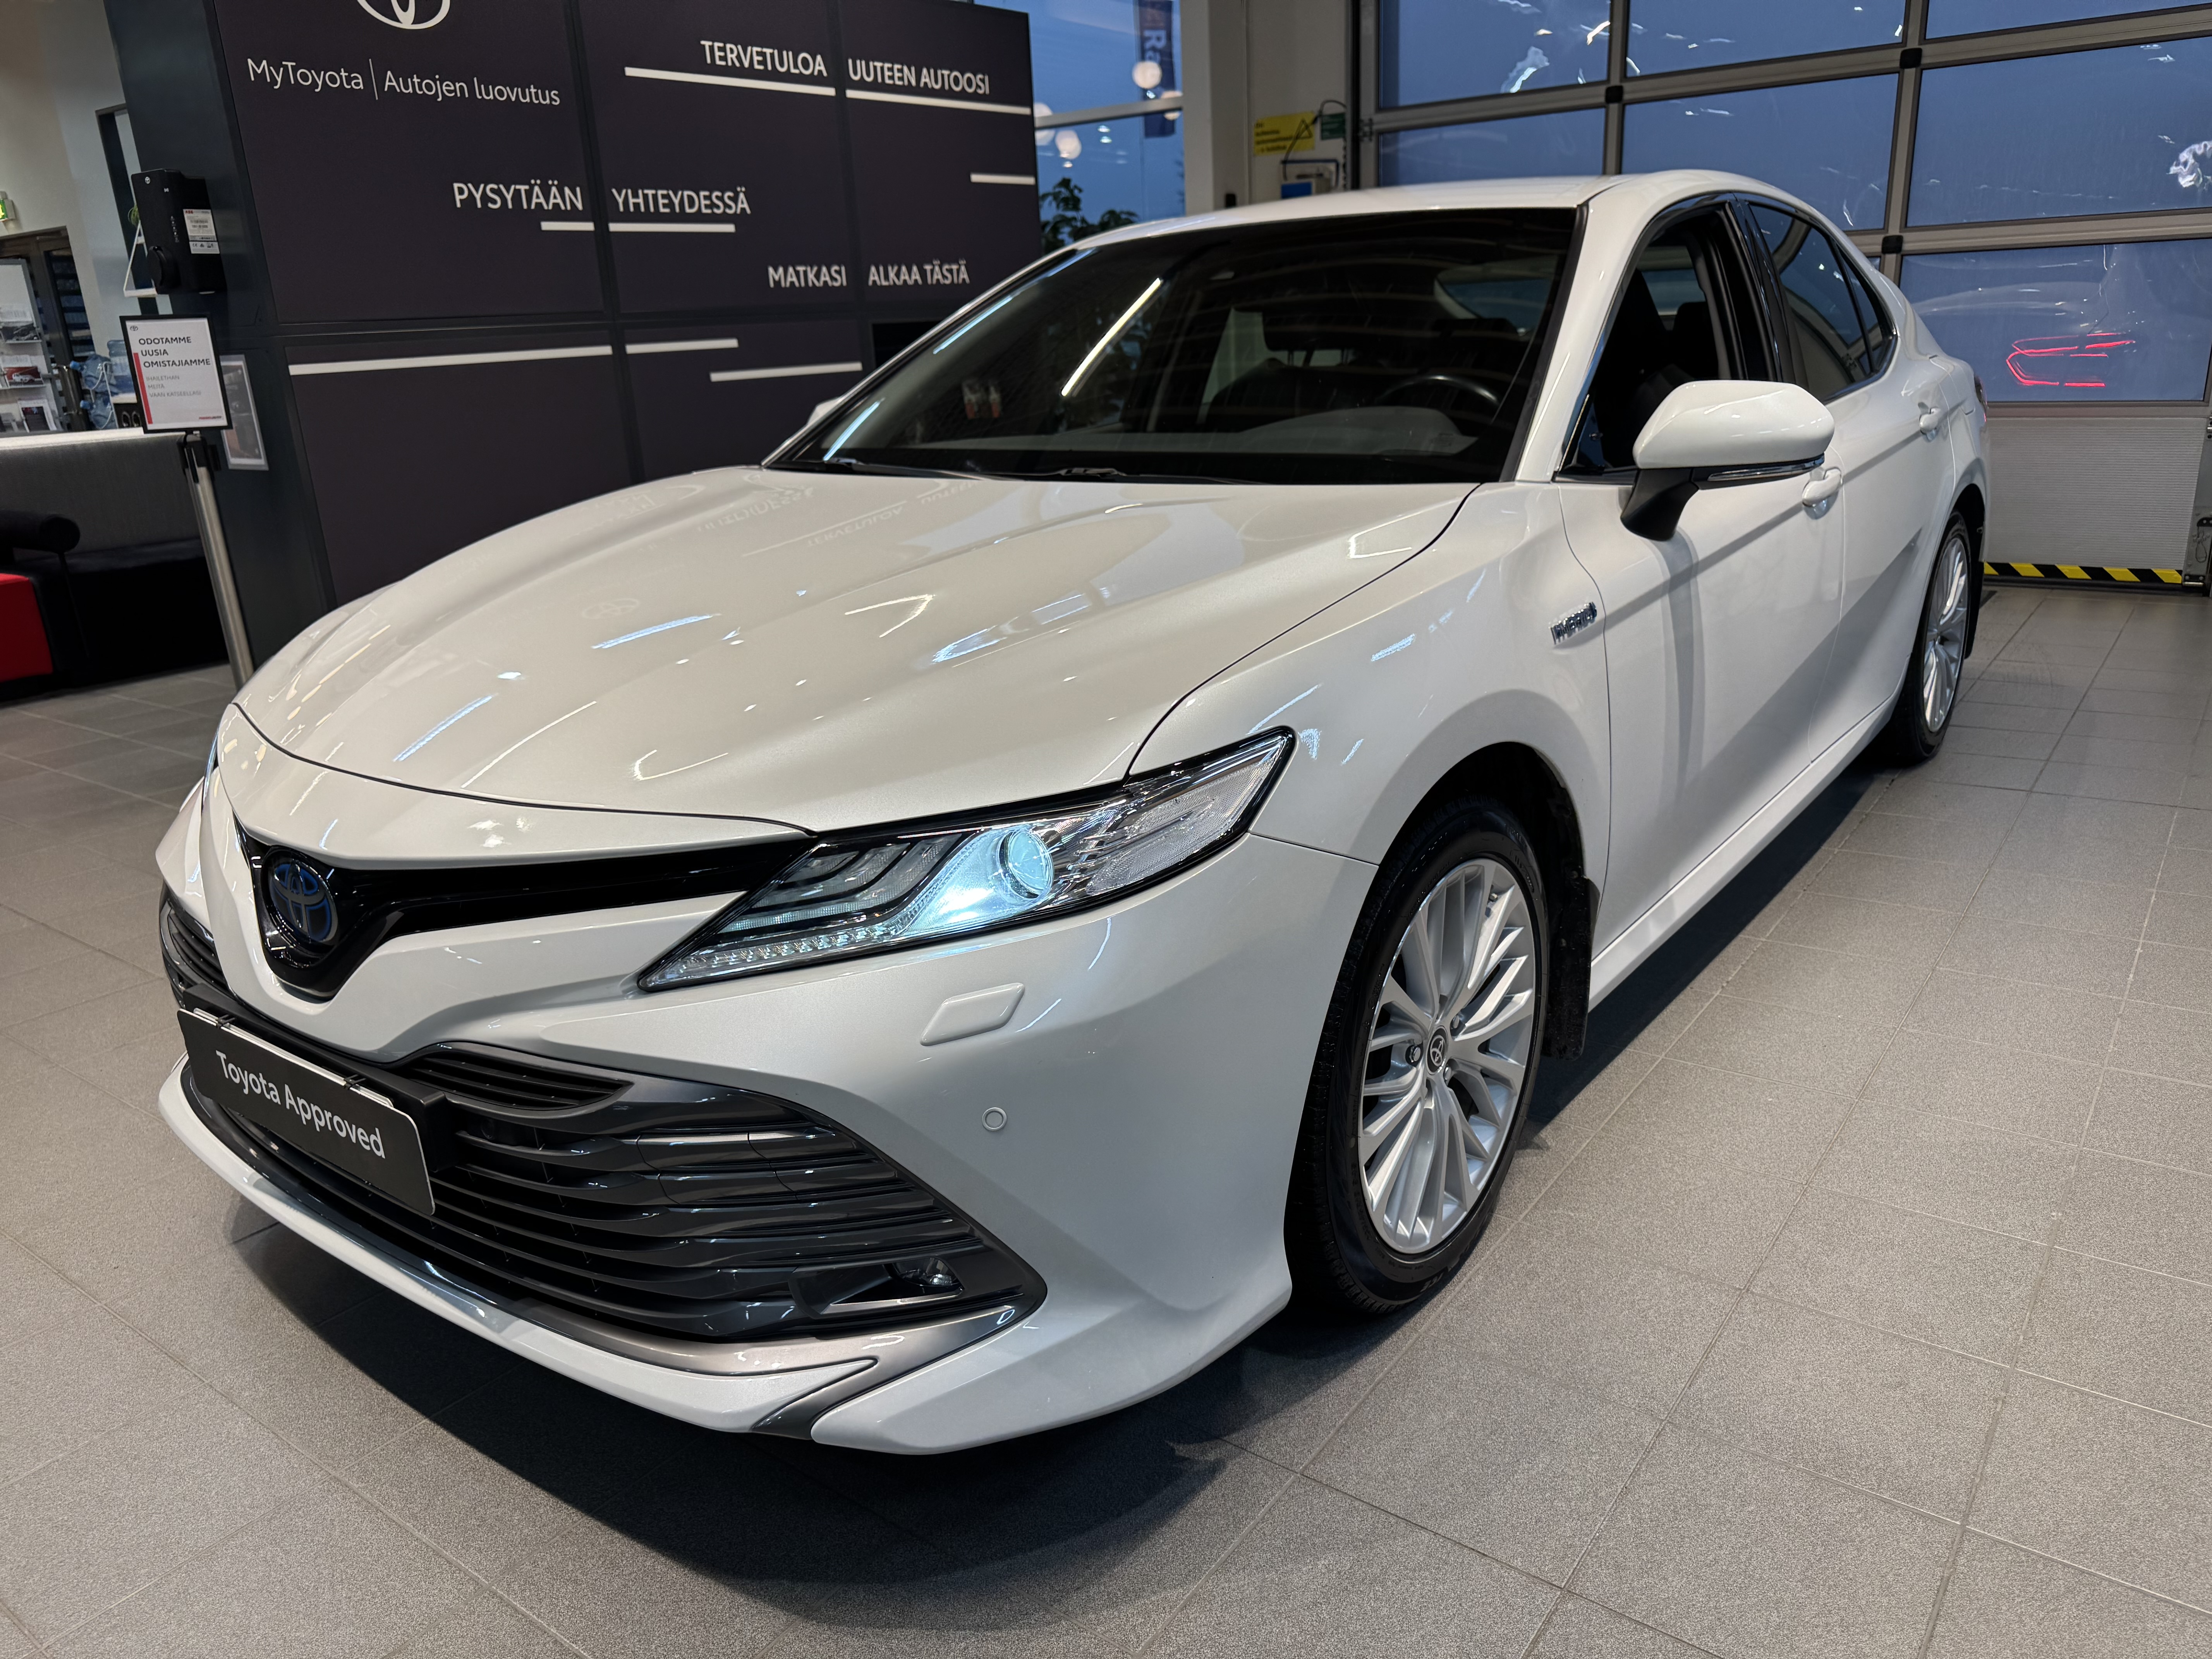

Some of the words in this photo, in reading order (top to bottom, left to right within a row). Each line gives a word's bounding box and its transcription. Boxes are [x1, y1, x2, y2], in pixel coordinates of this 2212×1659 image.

[247, 58, 364, 92] MyToyota
[384, 70, 469, 101] Autojen
[474, 77, 560, 105] luovutus
[700, 40, 828, 77] TERVETULOA
[848, 58, 917, 87] UUTEEN
[920, 67, 990, 95] AUTOOSI
[452, 179, 584, 211] PYSYTÄÄN
[611, 186, 751, 215] YHTEYDESSÄ
[768, 265, 847, 288] MATKASI
[868, 264, 922, 286] ALKAA
[923, 258, 970, 284] TÄSTÄ
[139, 336, 192, 345] ODOTAMME
[143, 359, 211, 368] OMISTAJIAMME
[216, 1050, 281, 1105] Toyota
[285, 1084, 386, 1159] Approved
